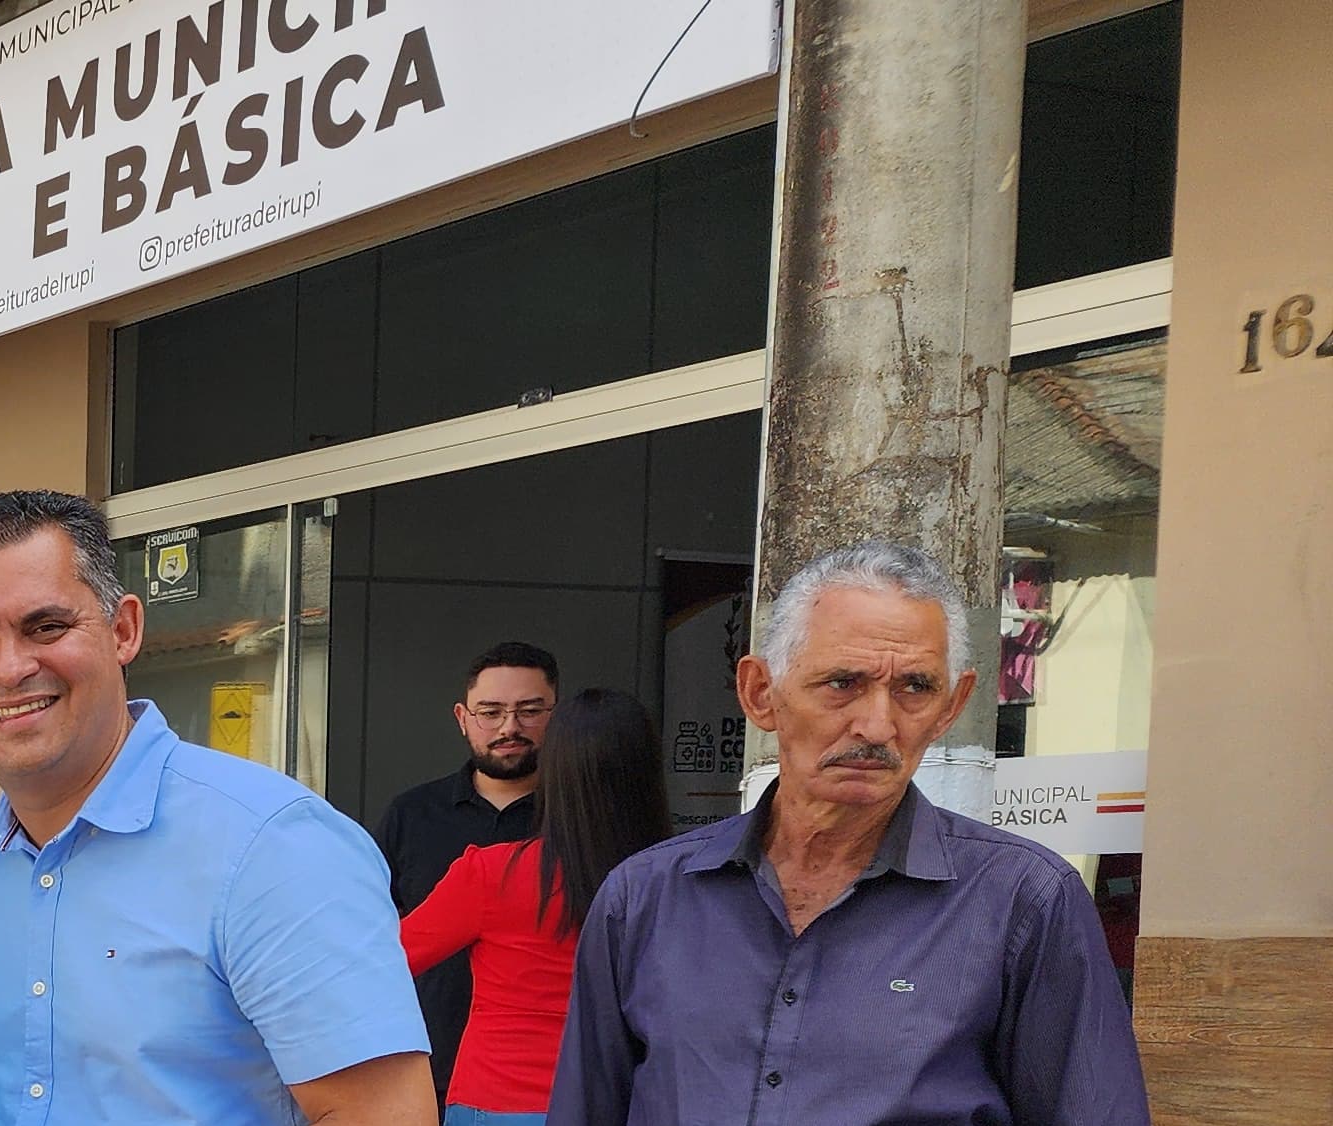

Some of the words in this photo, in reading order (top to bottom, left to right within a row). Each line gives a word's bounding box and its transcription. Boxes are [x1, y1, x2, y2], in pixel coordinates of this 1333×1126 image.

[44, 0, 386, 155] MUNIC
[32, 172, 71, 259] E
[101, 26, 446, 234] BÁSICA
[165, 181, 322, 264] prefeituradeirupi
[991, 806, 1067, 826] BÁSICA
[994, 785, 1092, 806] UNICIPAL
